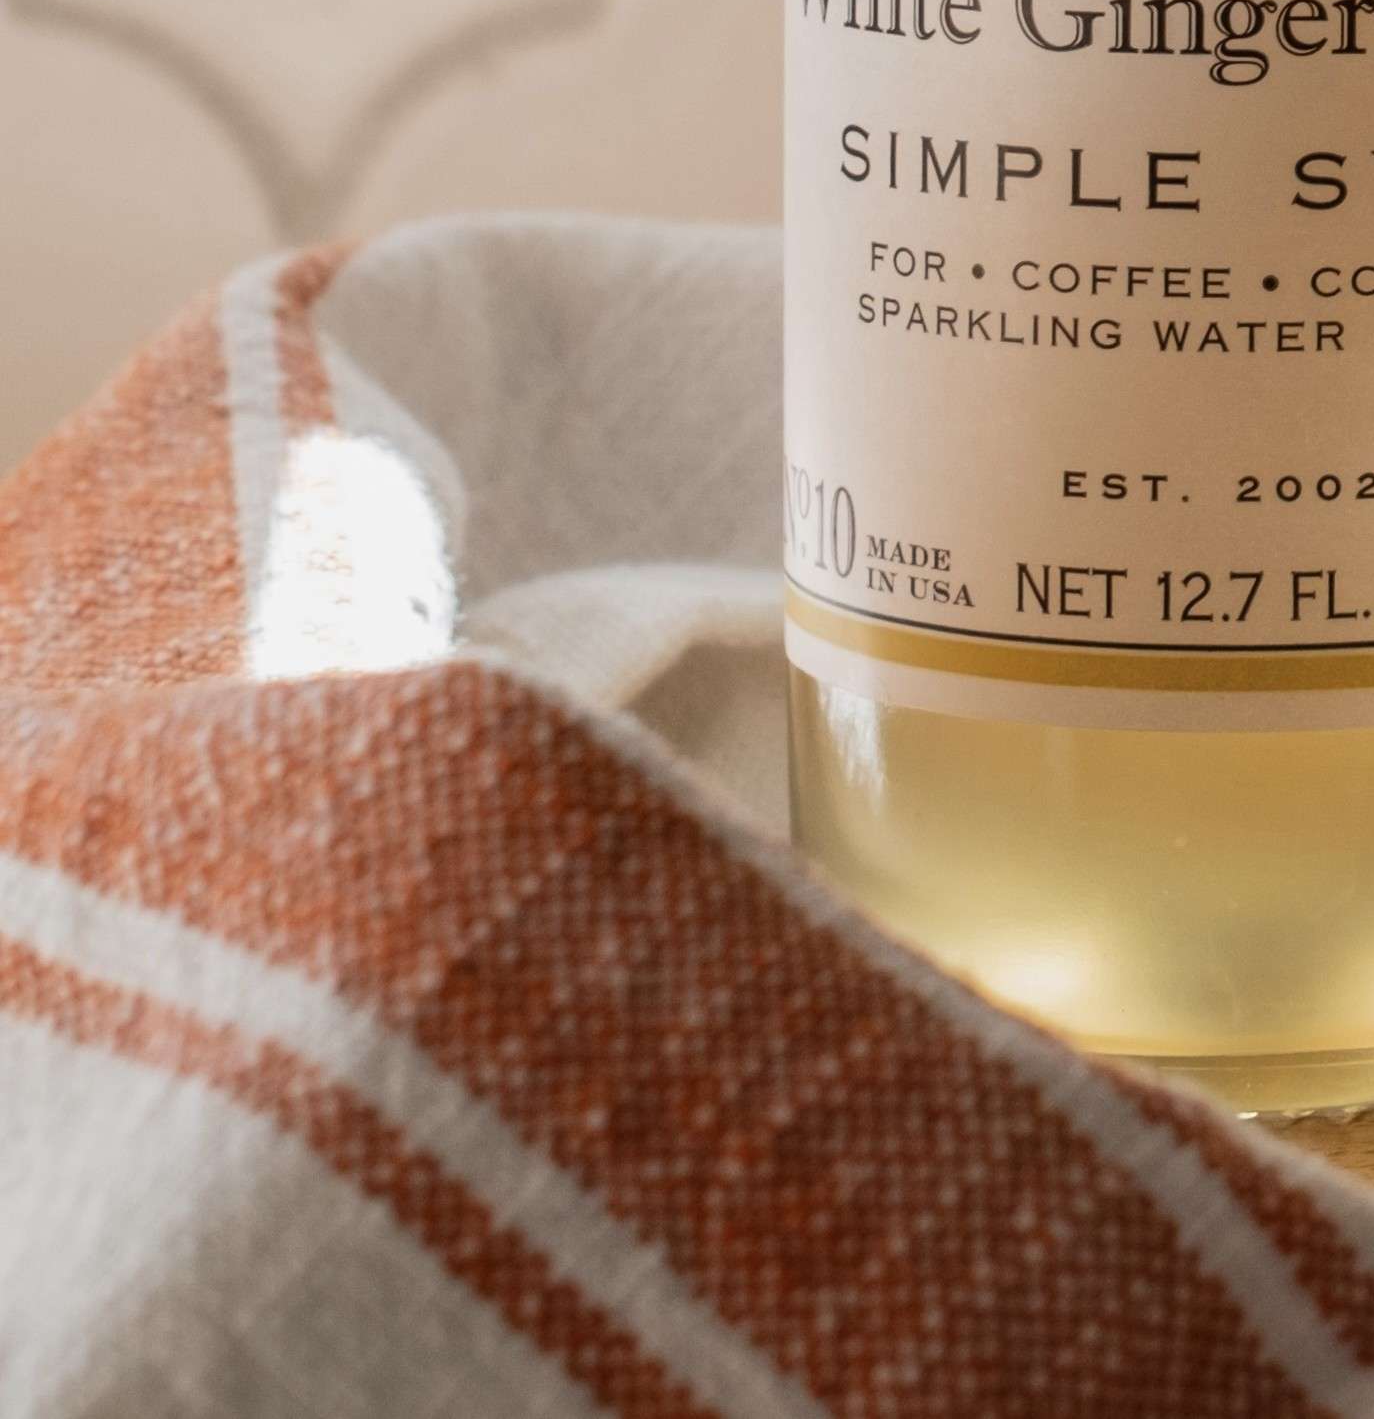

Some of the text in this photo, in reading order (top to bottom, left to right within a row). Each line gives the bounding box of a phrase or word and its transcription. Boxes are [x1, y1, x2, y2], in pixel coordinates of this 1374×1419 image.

[839, 123, 1201, 214] SIMPLE
[870, 240, 946, 283] FOR
[1011, 260, 1232, 300] COFFEE
[857, 293, 1124, 351] SPARKLING
[1152, 319, 1346, 354] WATER
[1062, 469, 1190, 504] EST.
[864, 531, 954, 574] MADE
[865, 565, 978, 609] IN USA
[1015, 561, 1129, 620] NET
[1156, 570, 1265, 623] 12.7
